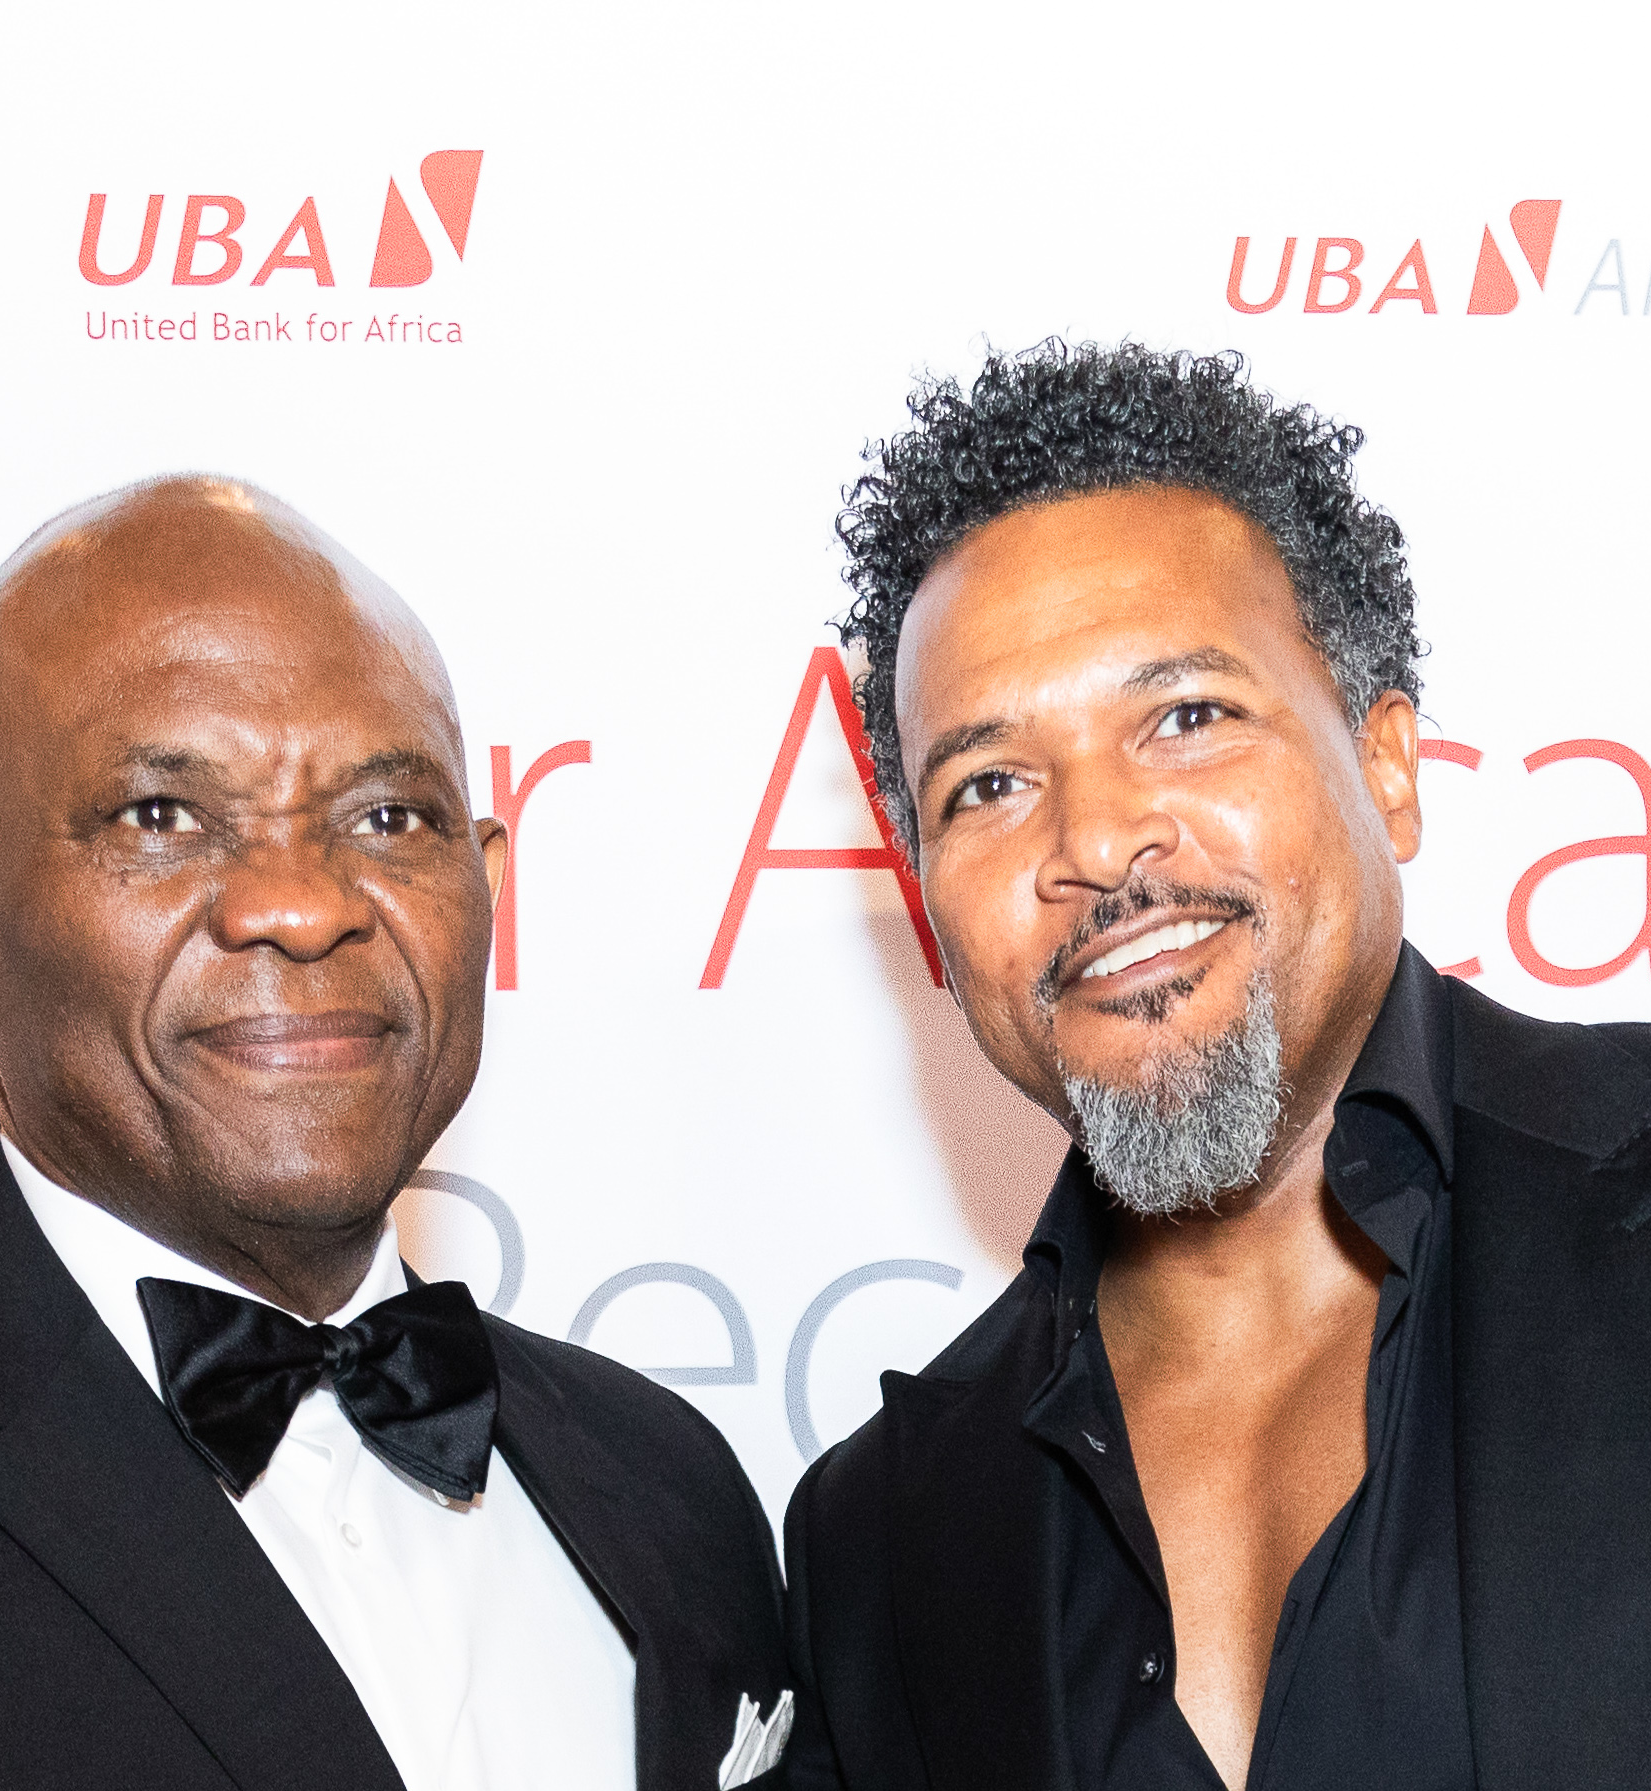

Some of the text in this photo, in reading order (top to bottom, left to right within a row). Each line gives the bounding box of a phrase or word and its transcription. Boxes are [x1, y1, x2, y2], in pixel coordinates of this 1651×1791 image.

[76, 191, 337, 289] UBA
[1224, 234, 1439, 316] UBA
[84, 309, 464, 345] United Bank for Africa
